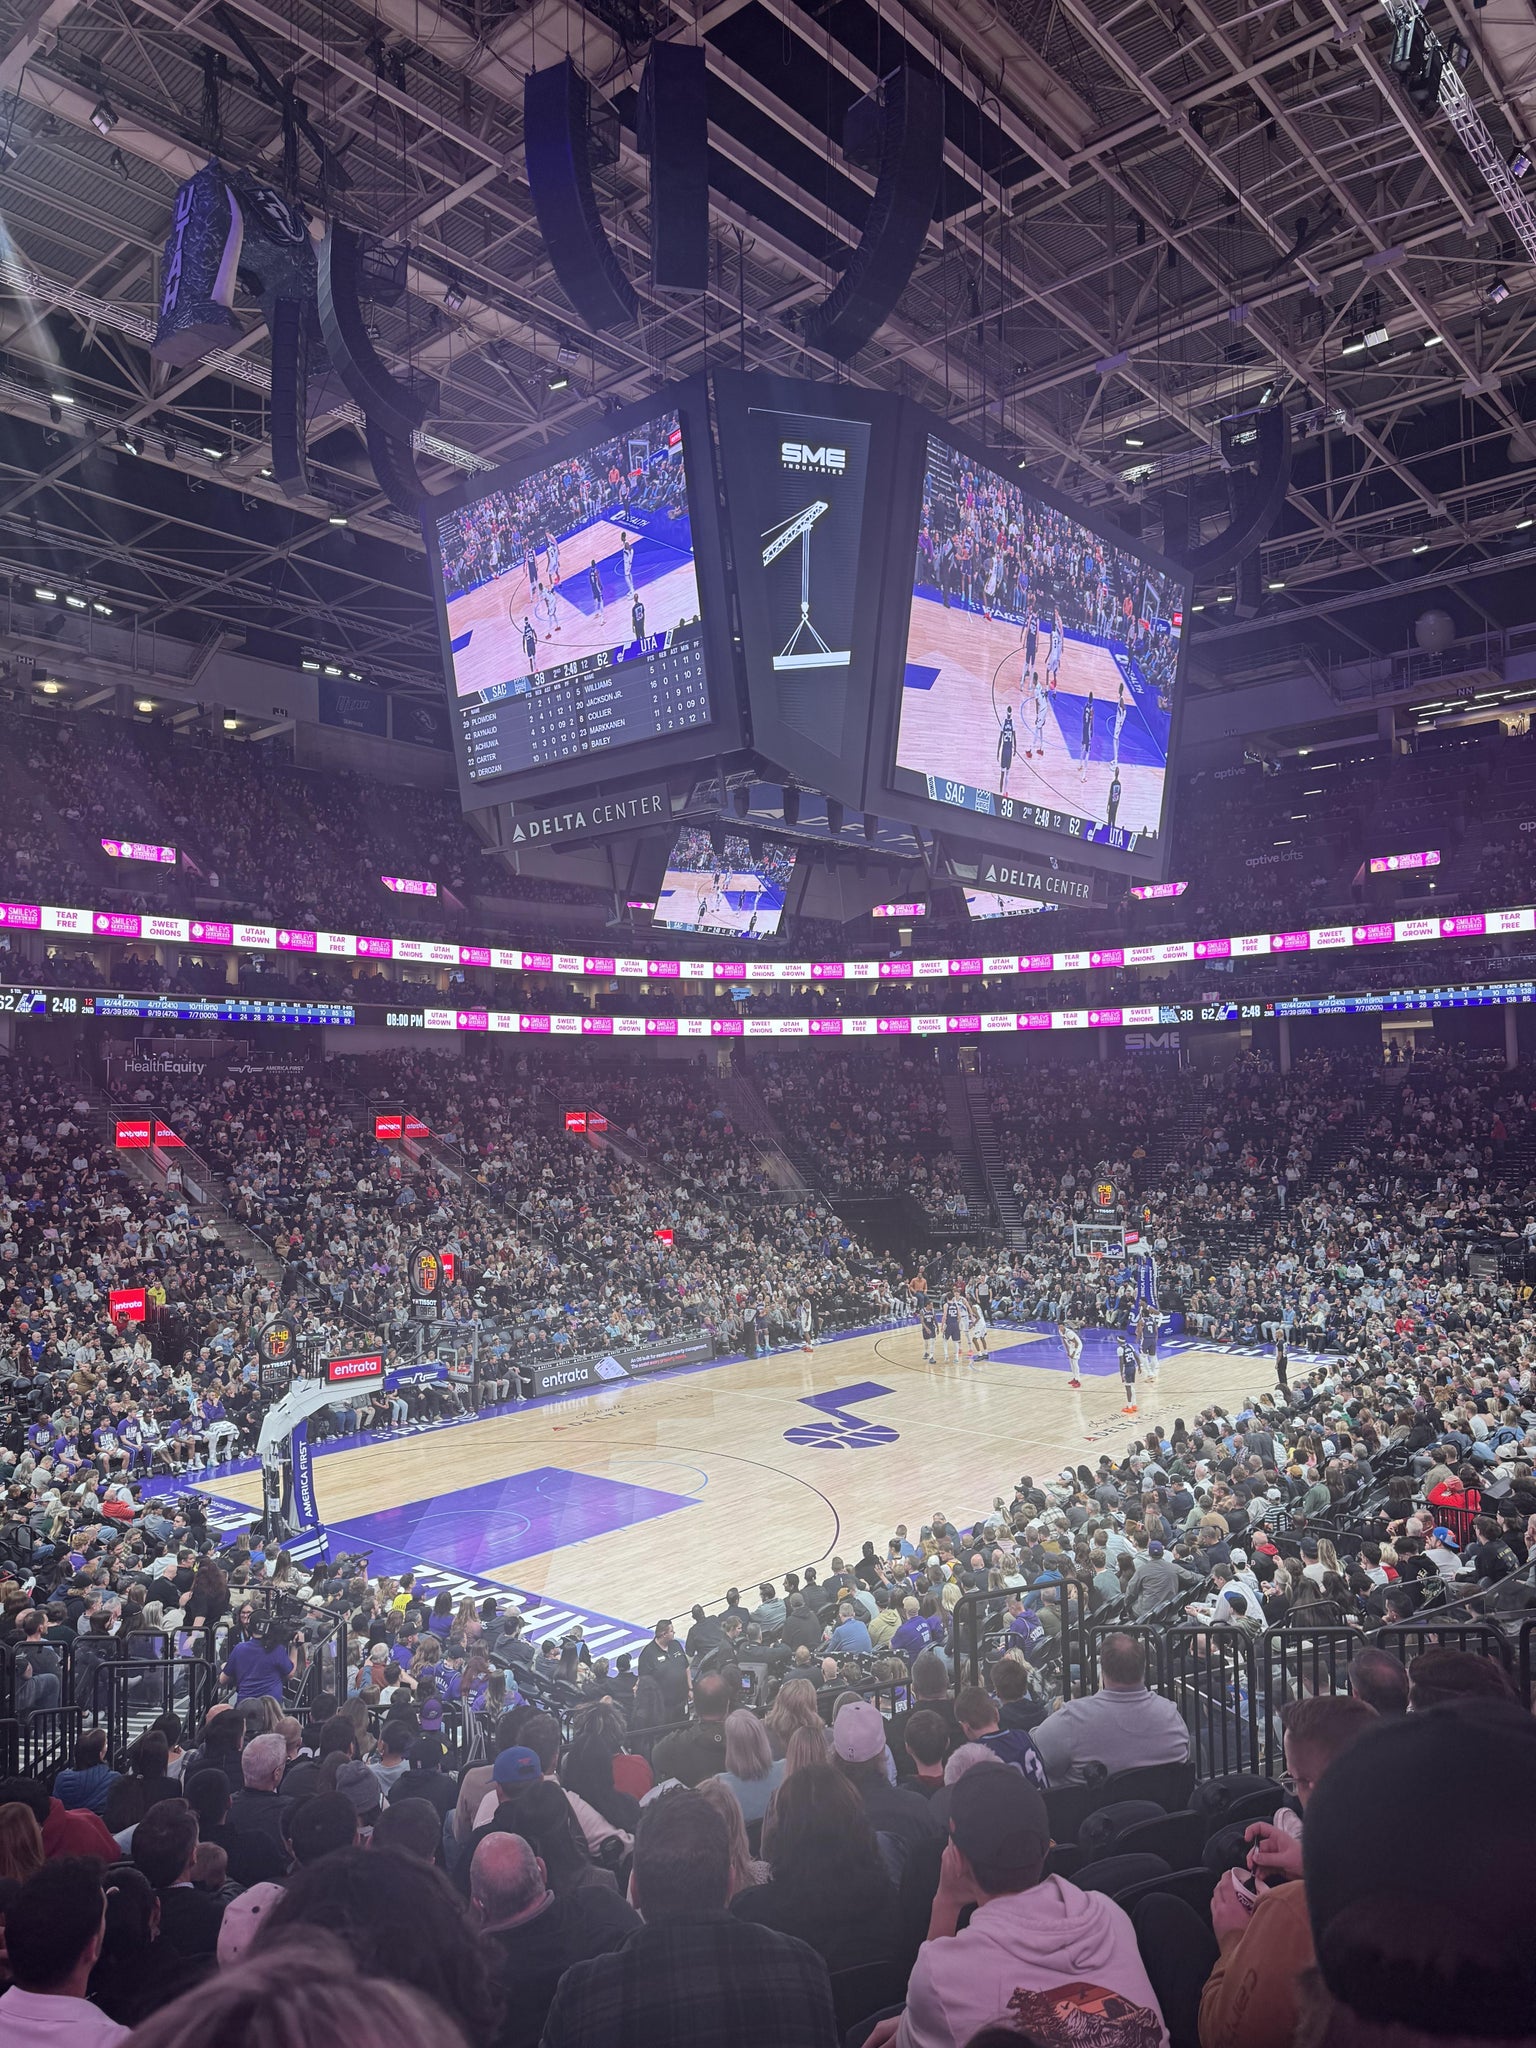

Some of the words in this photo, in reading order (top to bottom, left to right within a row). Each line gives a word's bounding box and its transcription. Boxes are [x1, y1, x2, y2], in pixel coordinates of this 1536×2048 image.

[162, 184, 194, 316] UTAH
[782, 442, 845, 468] SME
[784, 463, 843, 475] INDUSTRIES
[597, 652, 608, 666] 62
[640, 636, 658, 652] UTA
[564, 662, 577, 676] 2:48
[581, 660, 588, 669] 12
[492, 684, 506, 698] SAC
[534, 672, 545, 685] 38
[576, 701, 584, 710] 20
[586, 692, 613, 706] JACKSON
[684, 671, 691, 679] 10
[584, 679, 612, 692] WILLIAMS
[472, 713, 497, 726] PLOWDEN
[580, 729, 587, 737] 23
[590, 719, 625, 735] MARKKANEN
[687, 700, 695, 709] 09
[588, 708, 612, 721] COLLIER
[473, 726, 497, 738] RAYNAUD
[591, 737, 611, 748] BAILEY
[689, 714, 696, 722] 12
[475, 740, 499, 751] ACHIUWA
[476, 753, 496, 764] CARTER
[478, 765, 502, 776] DEROZAN
[945, 782, 965, 804] SAC
[530, 812, 586, 838] DELTA
[592, 795, 662, 824] CENTER
[1001, 798, 1013, 818] 38
[1035, 808, 1050, 827] 2:48
[1054, 815, 1061, 827] 12
[1069, 818, 1080, 835] 62
[1109, 828, 1124, 846] UTA
[1246, 854, 1279, 868] aptive
[1281, 850, 1303, 861] lofts
[1000, 868, 1042, 890] DELTA
[1046, 877, 1089, 899] CENTER
[8, 907, 38, 917] SMILEYS
[56, 911, 78, 919] TEAR
[111, 916, 138, 926] SMILEYS
[152, 920, 178, 928] SWEET
[150, 928, 181, 937] ONIONS
[241, 936, 270, 944] GROWN
[398, 950, 423, 958] ONIONS
[52, 997, 76, 1013] 2:48
[1242, 1006, 1260, 1017] 2:48
[387, 1013, 408, 1026] 08:00
[411, 1014, 423, 1028] PM
[1180, 1009, 1193, 1020] 38
[1201, 1008, 1214, 1020] 62
[1125, 1032, 1180, 1049] SME
[125, 1060, 205, 1075] HealthEquity
[270, 1331, 288, 1342] 2:48
[272, 1342, 285, 1355] 12
[1162, 1340, 1264, 1356] UTAH
[1125, 1352, 1135, 1363] 29
[334, 1361, 376, 1376] entrata
[542, 1368, 588, 1387] entrata
[300, 1441, 308, 1469] FIRST
[301, 1471, 313, 1518] AMERICA
